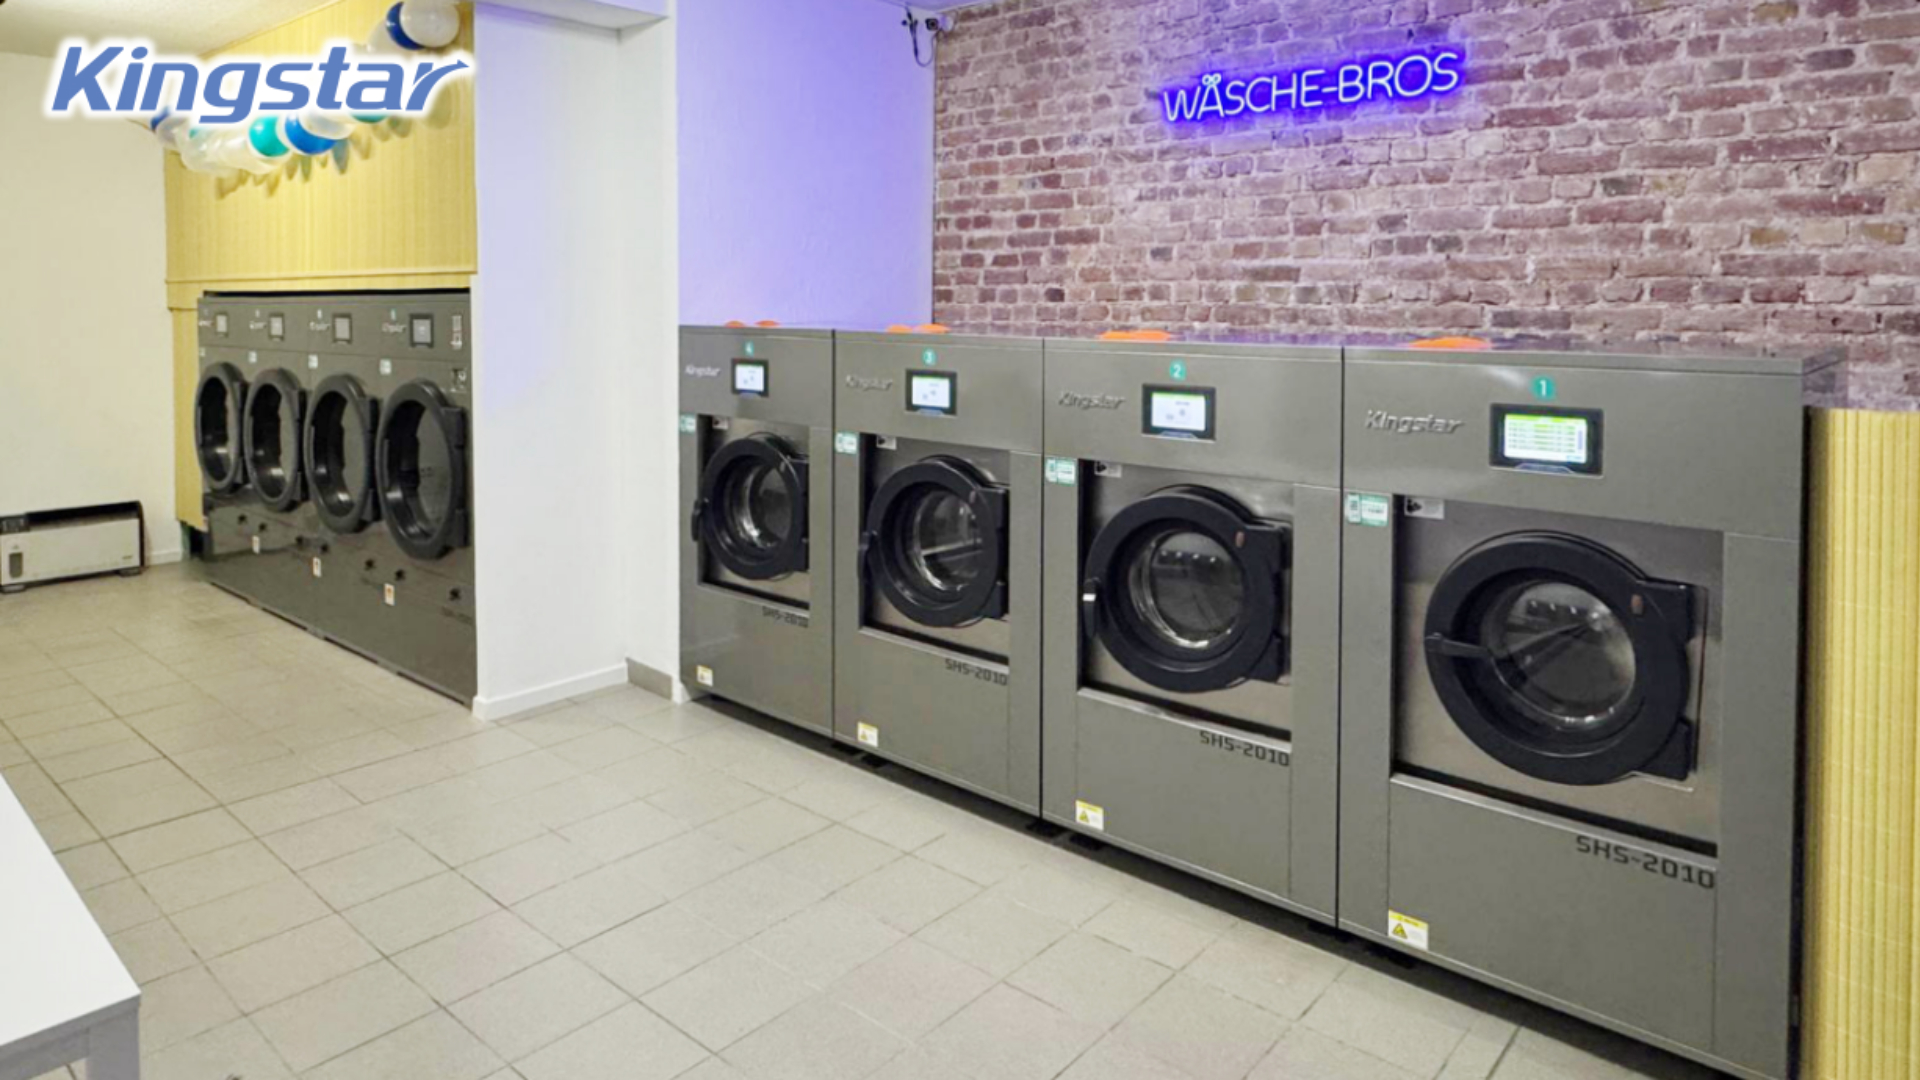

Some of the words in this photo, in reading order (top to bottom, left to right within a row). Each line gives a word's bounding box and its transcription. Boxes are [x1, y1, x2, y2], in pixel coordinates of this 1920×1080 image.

[1163, 52, 1459, 121] WÄSCHE-BROS
[1173, 364, 1182, 379] 2
[1539, 379, 1547, 397] 1
[1364, 409, 1463, 435] Kingstar
[944, 658, 1009, 686] SHS-2010
[1199, 730, 1290, 767] SHS-2010
[1576, 835, 1717, 889] SHS-2010
